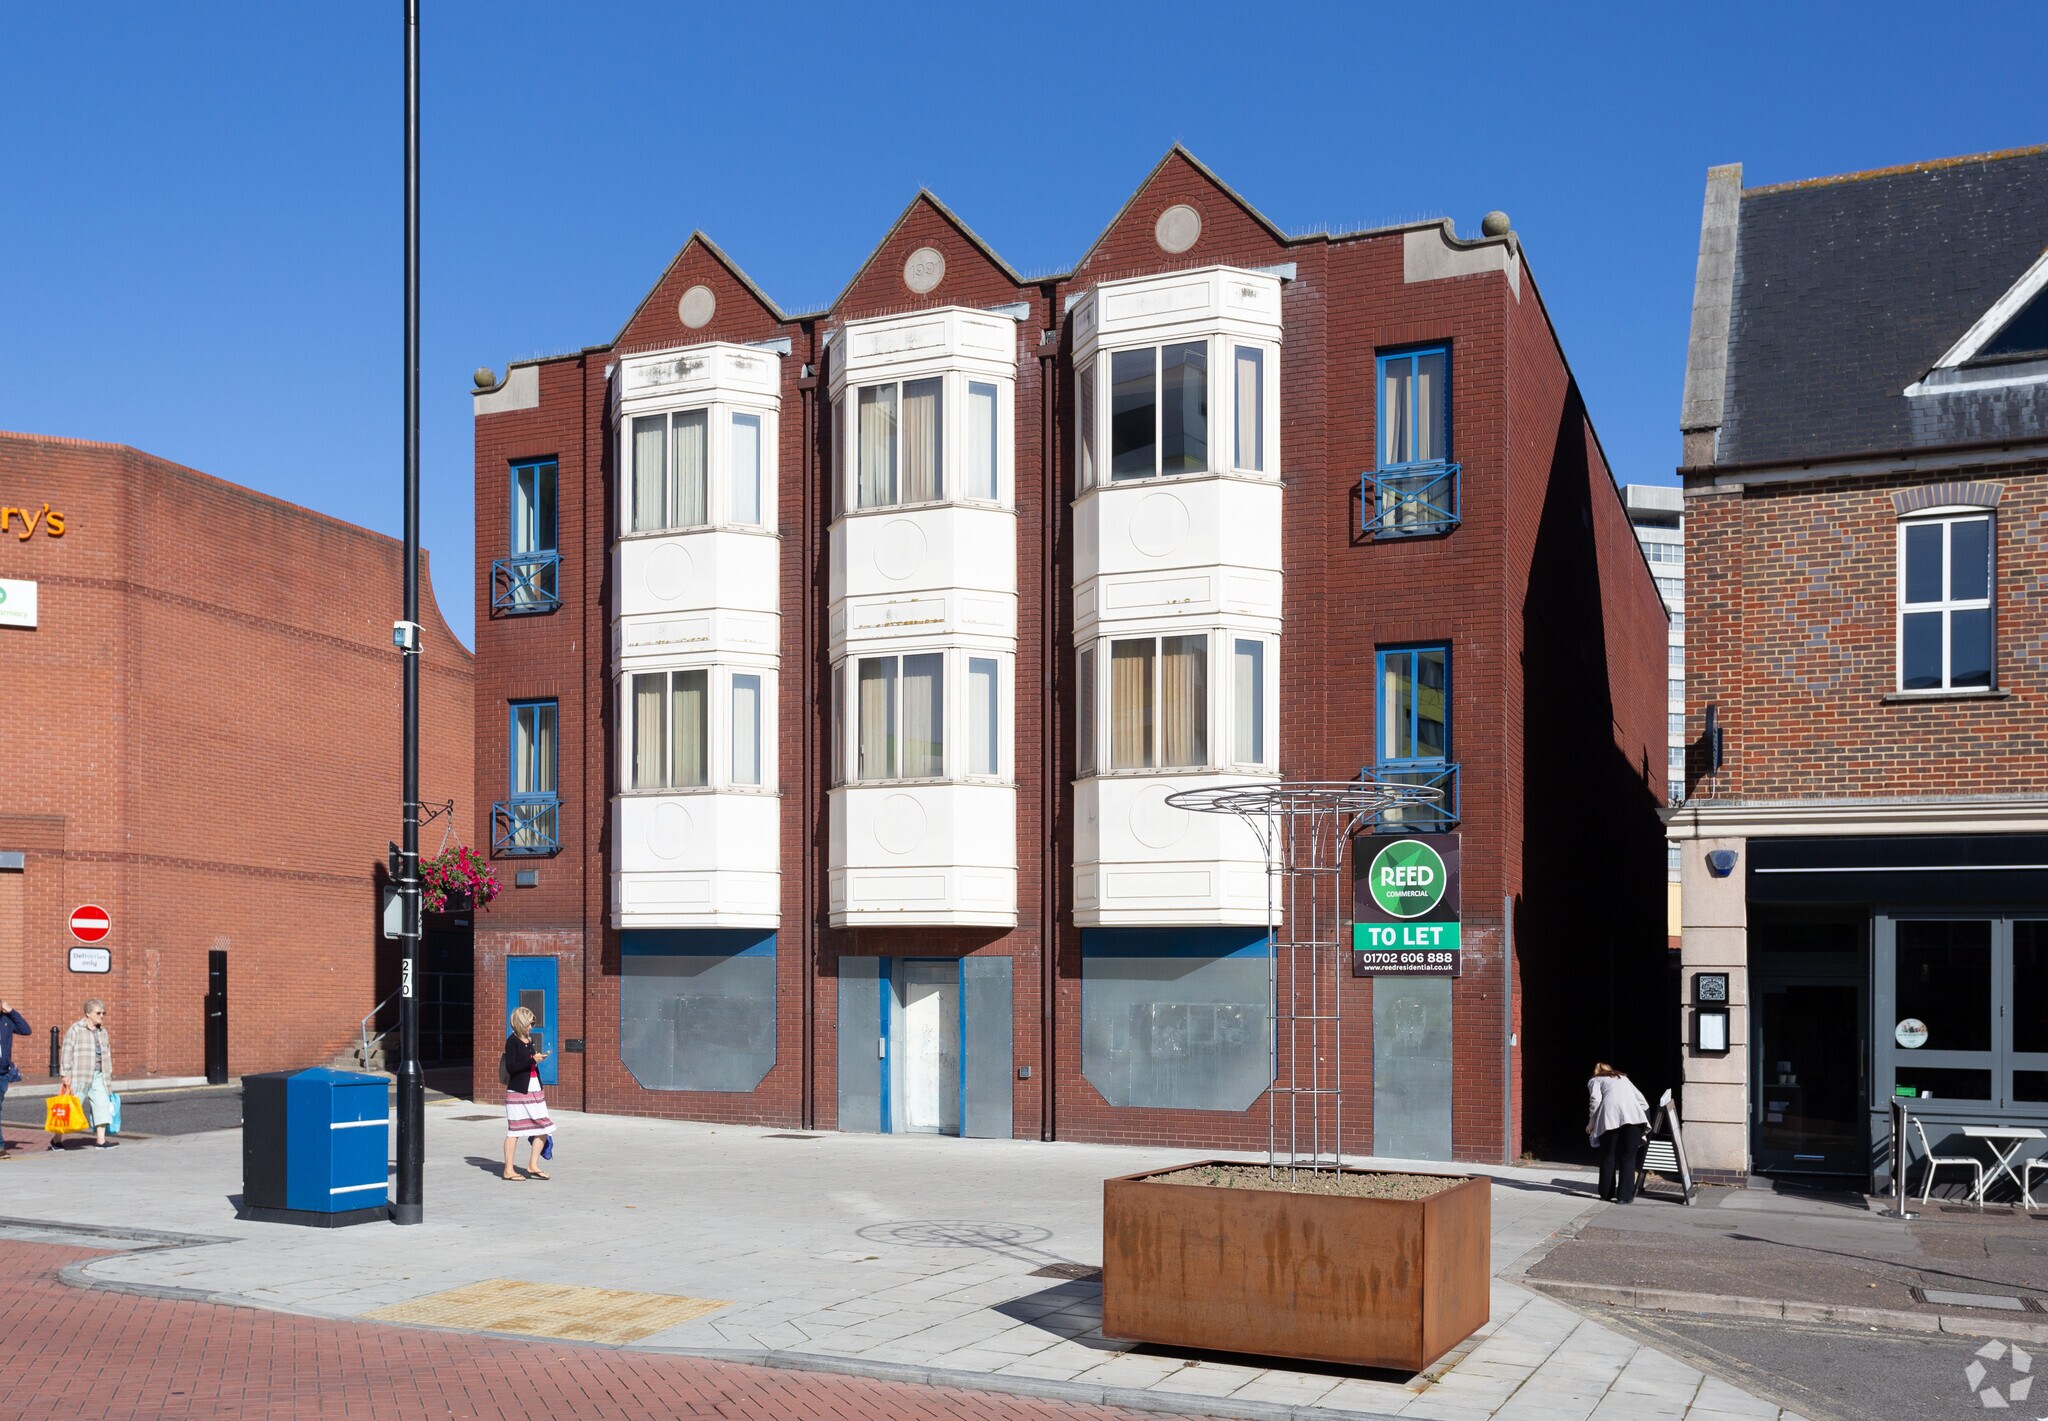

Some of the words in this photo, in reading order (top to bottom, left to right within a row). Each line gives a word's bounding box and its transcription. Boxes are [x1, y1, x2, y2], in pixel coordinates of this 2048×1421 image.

[908, 261, 940, 279] 1991
[1381, 866, 1434, 886] REED
[1368, 927, 1396, 945] TO
[1404, 926, 1443, 945] LET
[73, 952, 107, 960] Deliveries
[1363, 953, 1398, 963] 01702
[1400, 953, 1424, 963] 606
[1427, 953, 1453, 963] 888
